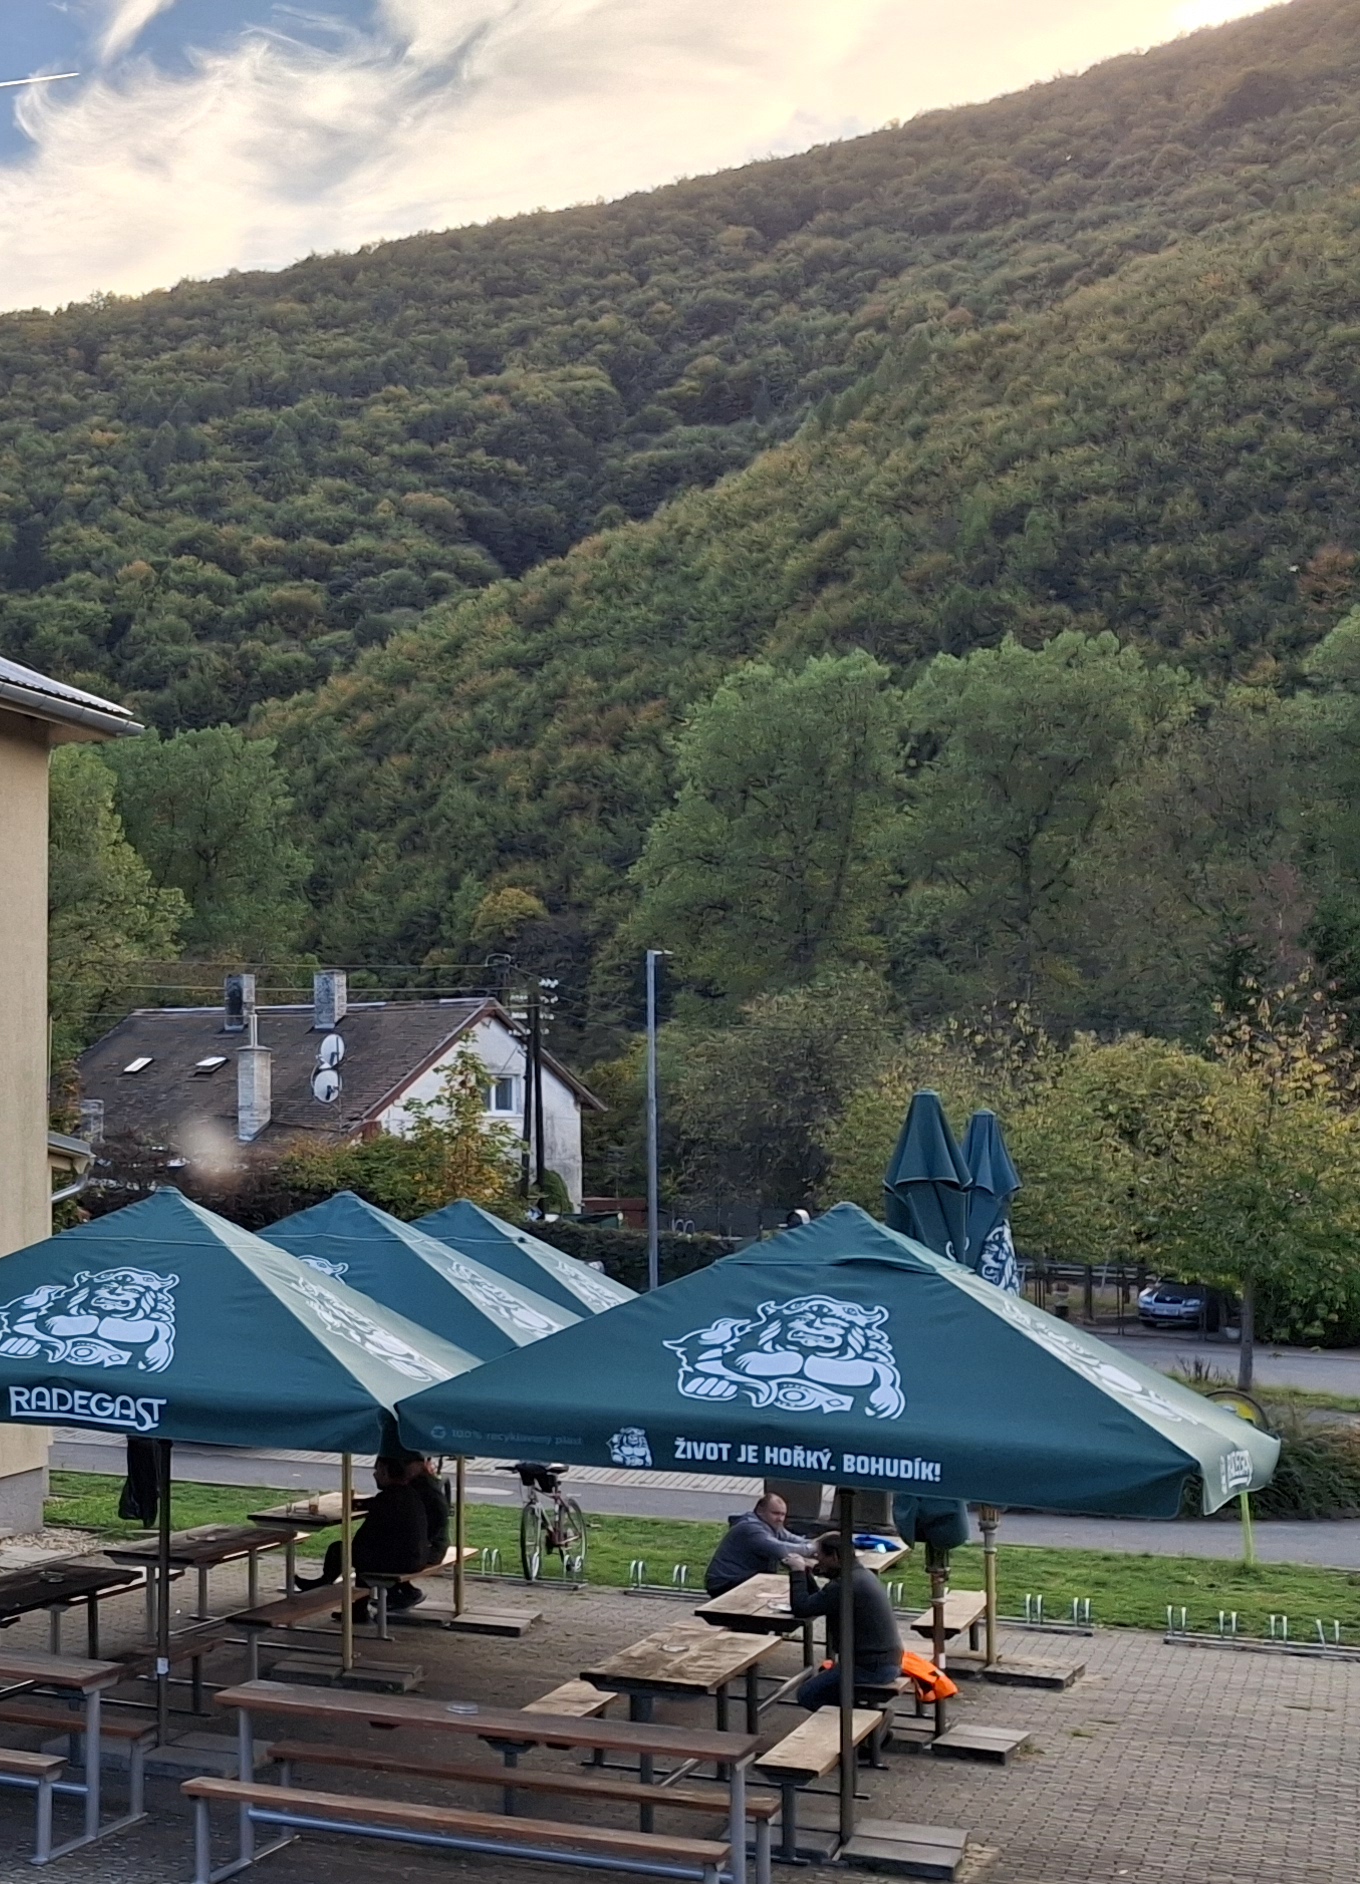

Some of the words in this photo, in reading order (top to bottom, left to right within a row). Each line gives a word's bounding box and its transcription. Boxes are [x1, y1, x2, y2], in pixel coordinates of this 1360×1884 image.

[8, 1386, 167, 1431] RADEGAST
[674, 1436, 732, 1463] ŽIVOT
[737, 1443, 759, 1464] JE
[764, 1445, 837, 1472] HOŘKÝ.
[842, 1452, 942, 1483] BOHUDÍK!
